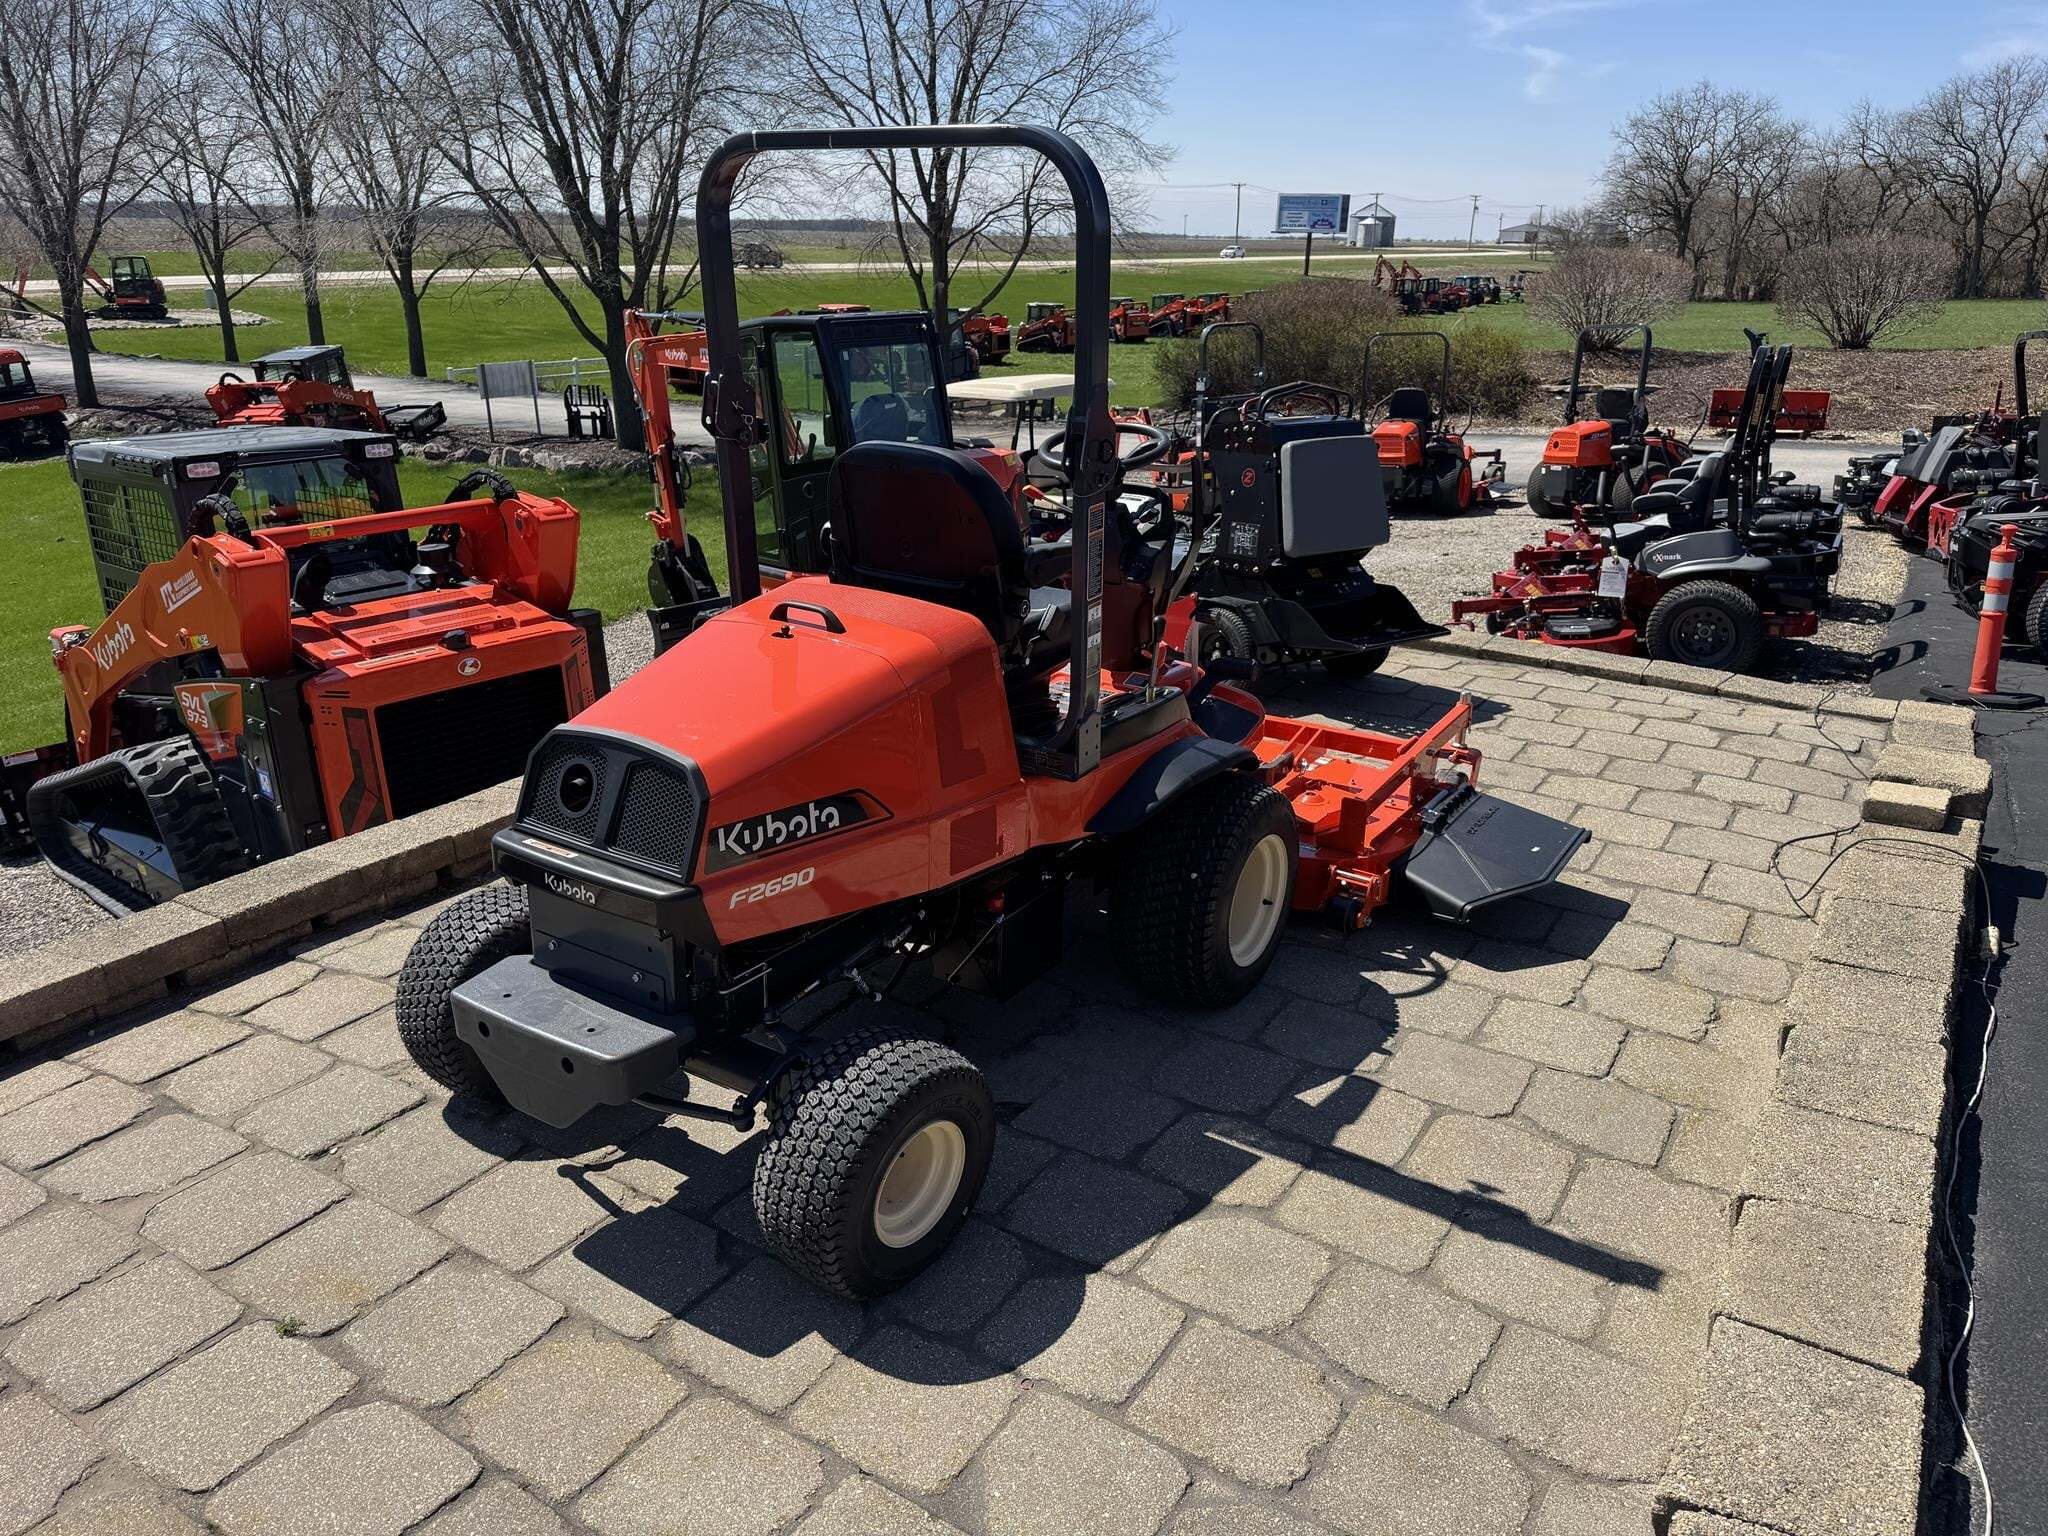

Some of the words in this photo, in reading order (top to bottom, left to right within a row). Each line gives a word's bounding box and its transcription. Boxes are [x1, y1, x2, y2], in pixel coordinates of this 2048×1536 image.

[93, 621, 136, 671] Kubota
[181, 691, 205, 714] SVL
[186, 709, 208, 729] 97-3
[717, 802, 840, 855] Kubota
[544, 872, 596, 905] Kubota
[729, 867, 815, 910] F2690
